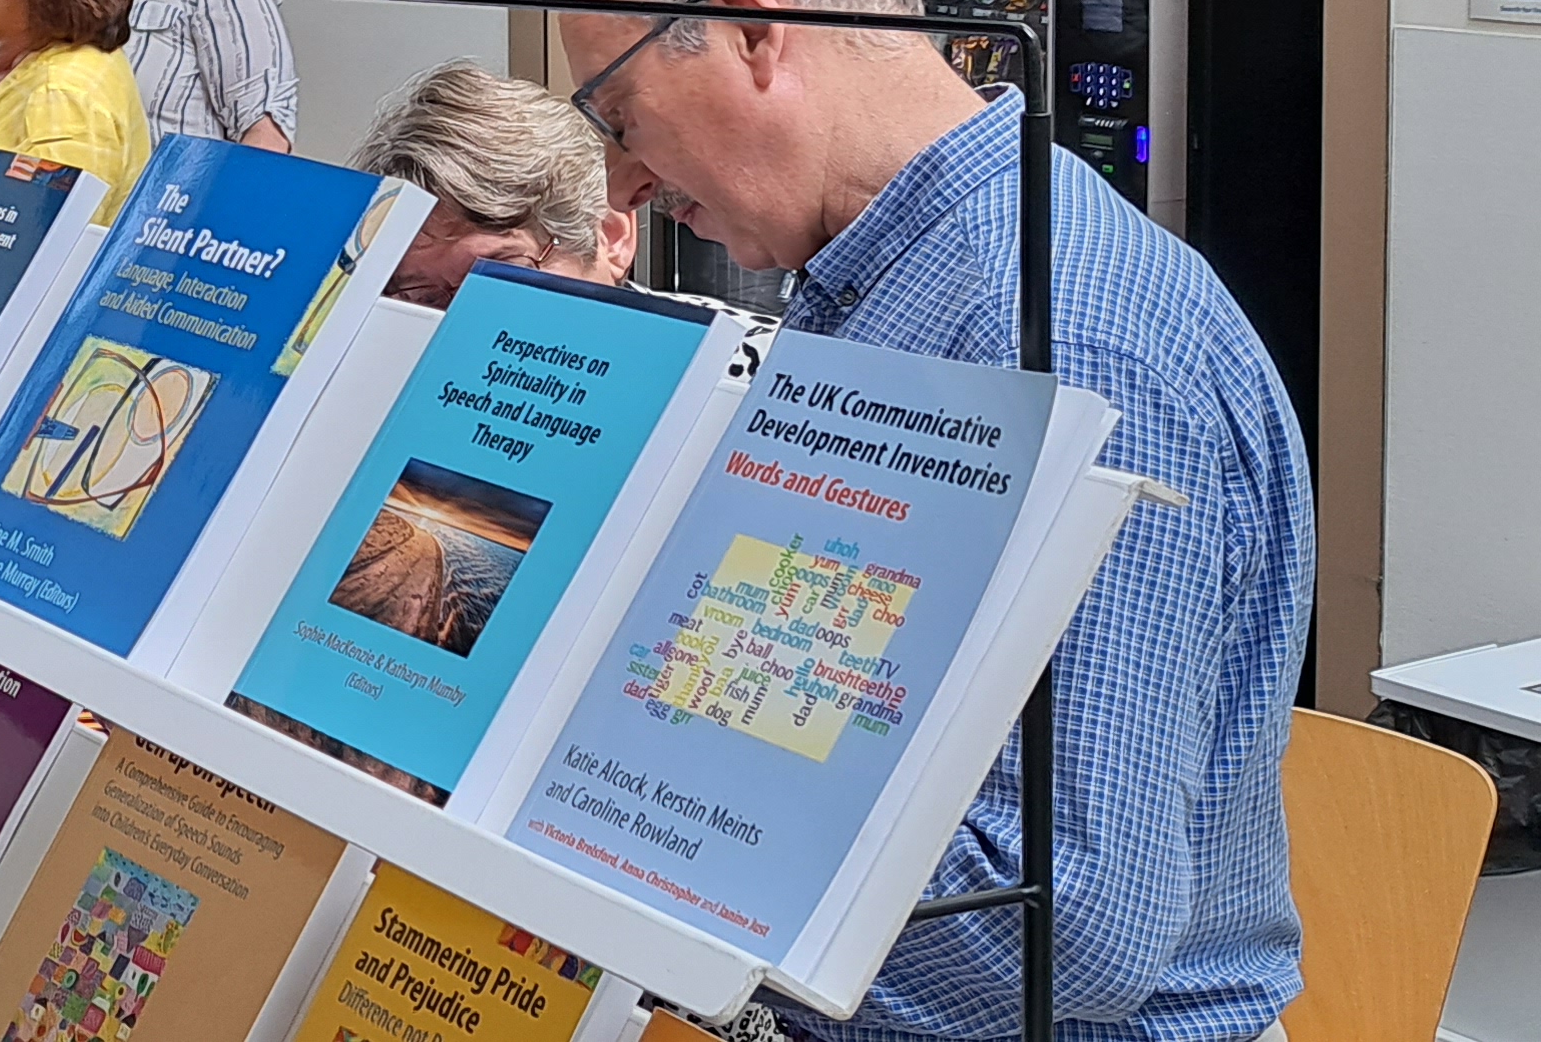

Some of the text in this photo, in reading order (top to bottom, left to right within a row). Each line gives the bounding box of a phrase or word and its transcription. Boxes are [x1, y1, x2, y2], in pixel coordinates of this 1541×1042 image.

[4, 205, 19, 224] in
[157, 183, 190, 214] The
[134, 217, 286, 280] Silent Partner?
[116, 257, 249, 312] Language, Interaction
[99, 289, 258, 352] and Aided Communication
[492, 329, 611, 378] Perspectives on
[481, 360, 588, 406] Spirituality in
[437, 380, 603, 445] Speech and Language
[767, 372, 1003, 450] The UK Communicative
[470, 422, 535, 464] Therapy
[746, 408, 1013, 496] Development Inventories
[724, 449, 912, 523] Words and Gestures
[6, 530, 20, 552] M.
[18, 536, 56, 568] Smith
[769, 533, 804, 587] cooker
[0, 560, 39, 598] Murray
[35, 578, 81, 614] (Editors)
[686, 571, 708, 599] cot
[862, 563, 921, 589] grandma
[293, 619, 467, 708] Sophie MacKenzie Katharyn Mumby
[722, 629, 748, 659] bye
[746, 637, 774, 659] ball
[815, 627, 852, 649] oops
[344, 671, 385, 701] (Editors)
[688, 669, 716, 709] woof
[724, 680, 750, 703] fish
[760, 658, 794, 680] choo
[812, 658, 894, 701] brushteeth
[876, 658, 901, 679] TV
[705, 702, 732, 727] dog
[835, 691, 903, 725] grandma
[122, 759, 189, 807] Comprehensive
[187, 794, 216, 822] Guide
[226, 816, 286, 861] Encouraging
[545, 778, 704, 862] and Caroline Rowland
[562, 743, 765, 849] Katie Alcock, Kerstin Meints
[103, 779, 243, 866] Generalization Speech Sounds
[92, 803, 250, 901] into Children's Everyday Conversation
[543, 822, 577, 850] Victoria
[645, 870, 702, 909] Christopher
[373, 906, 547, 1020] Stammering Pride
[337, 979, 404, 1036] Difference
[354, 949, 482, 1035] and Prejudice
